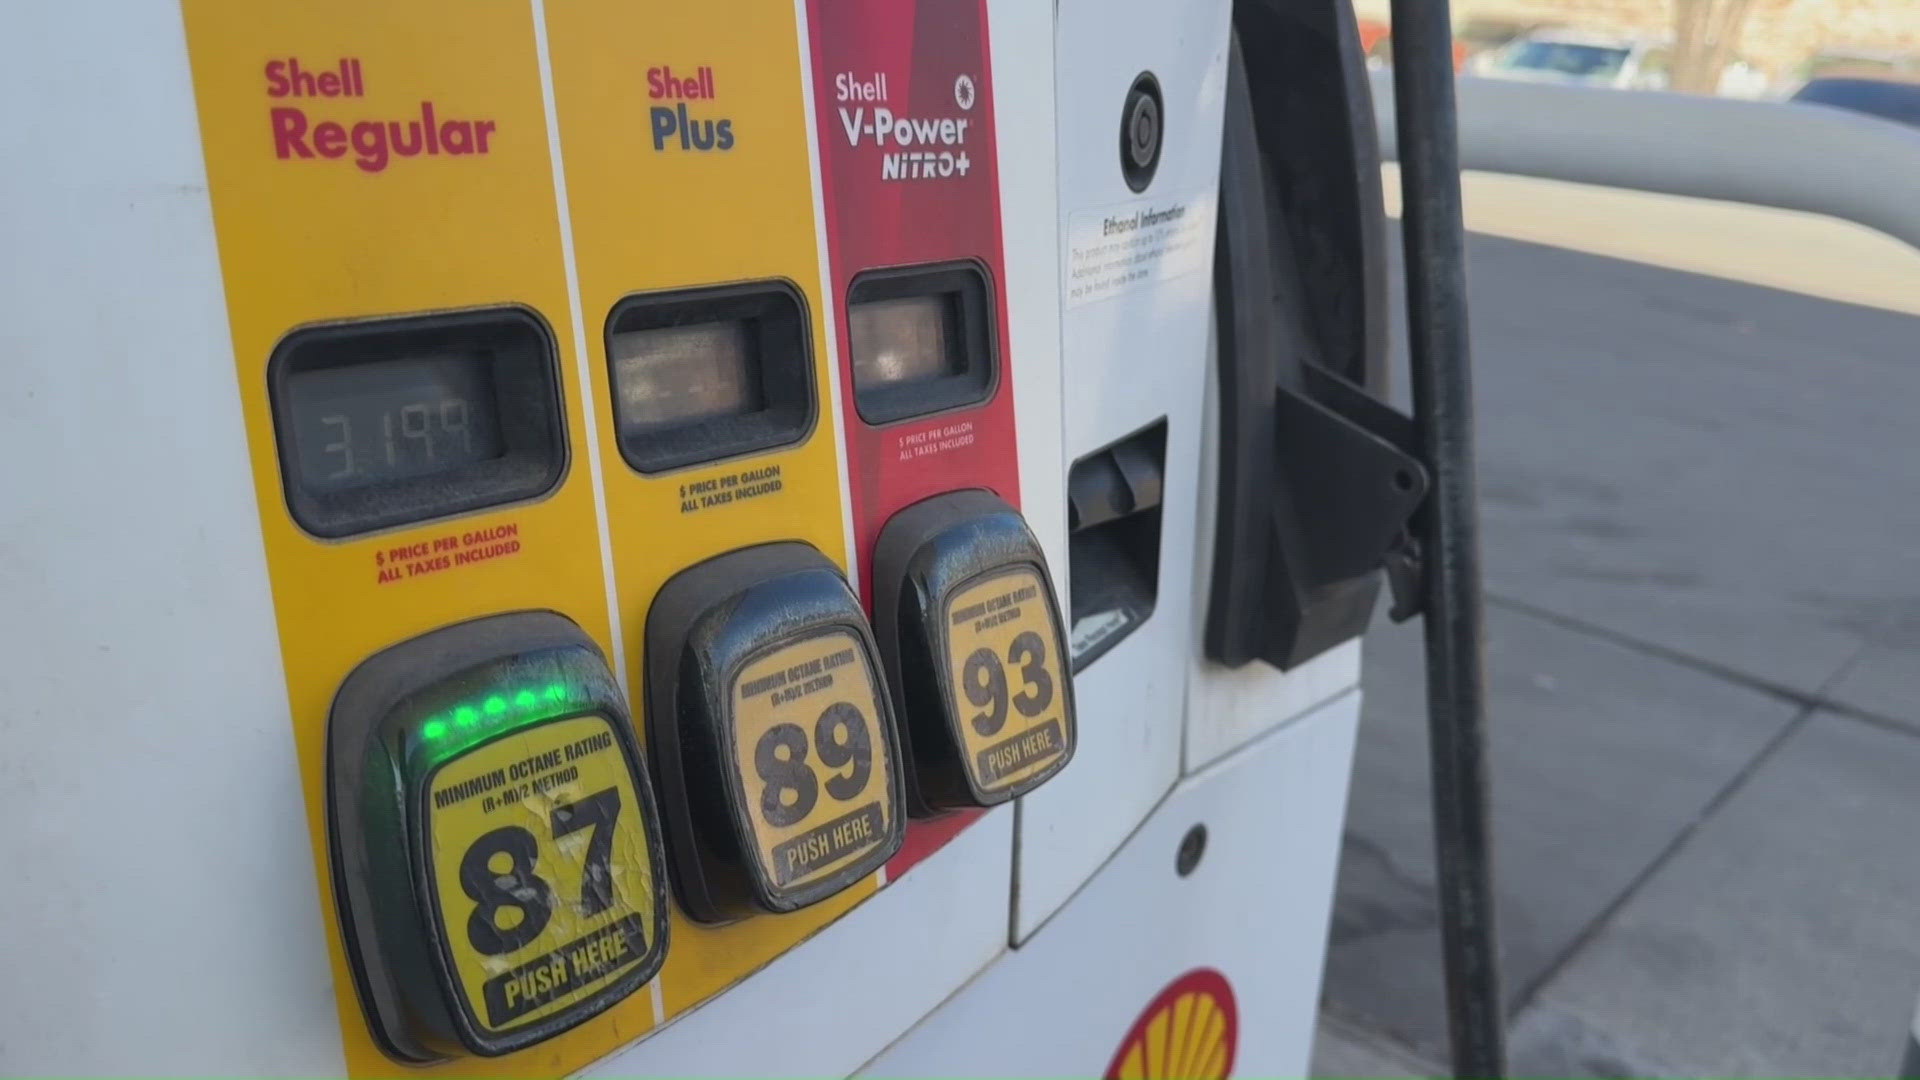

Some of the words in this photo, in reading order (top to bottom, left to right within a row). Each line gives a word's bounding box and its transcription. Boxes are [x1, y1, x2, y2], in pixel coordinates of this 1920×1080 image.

[265, 57, 364, 98] Shell
[647, 65, 715, 100] Shell
[836, 71, 888, 101] Shell
[270, 101, 496, 173] Regular
[650, 103, 735, 151] Plus
[838, 107, 968, 146] V-Power
[1103, 210, 1138, 236] Ethanol
[1141, 202, 1185, 228] Information
[900, 450, 913, 461] ALL
[914, 442, 938, 456] TAXES
[939, 434, 974, 451] INCLUDED
[906, 432, 926, 445] PRICE
[928, 429, 942, 440] PER
[943, 421, 973, 437] GALLON
[680, 485, 686, 498] $
[689, 479, 717, 495] PRICE
[720, 474, 738, 488] PER
[741, 465, 781, 484] GALLON
[681, 499, 699, 514] ALL
[701, 491, 732, 508] TAXES
[735, 480, 782, 500] INCLUDED
[376, 551, 385, 566] $
[389, 542, 429, 562] PRICE
[433, 536, 458, 553] PER
[462, 523, 518, 546] GALLON
[378, 568, 403, 584] ALL
[406, 556, 451, 577] TAXES
[454, 540, 520, 566] INCLUDED
[788, 658, 822, 682] OCTANE
[963, 631, 1053, 737] 93
[434, 768, 506, 810] MINIMUM
[509, 748, 563, 781] OCTANE
[564, 731, 612, 761] RATING
[754, 701, 872, 828] 89
[988, 743, 1021, 773] PUSH
[1022, 728, 1052, 759] HERE
[482, 783, 529, 814] (R+M)/2
[532, 766, 579, 794] METHOD
[787, 834, 830, 871] PUSH
[832, 814, 872, 849] HERE
[460, 785, 621, 956] 87
[504, 956, 568, 1009] PUSH
[572, 928, 628, 976] HERE
